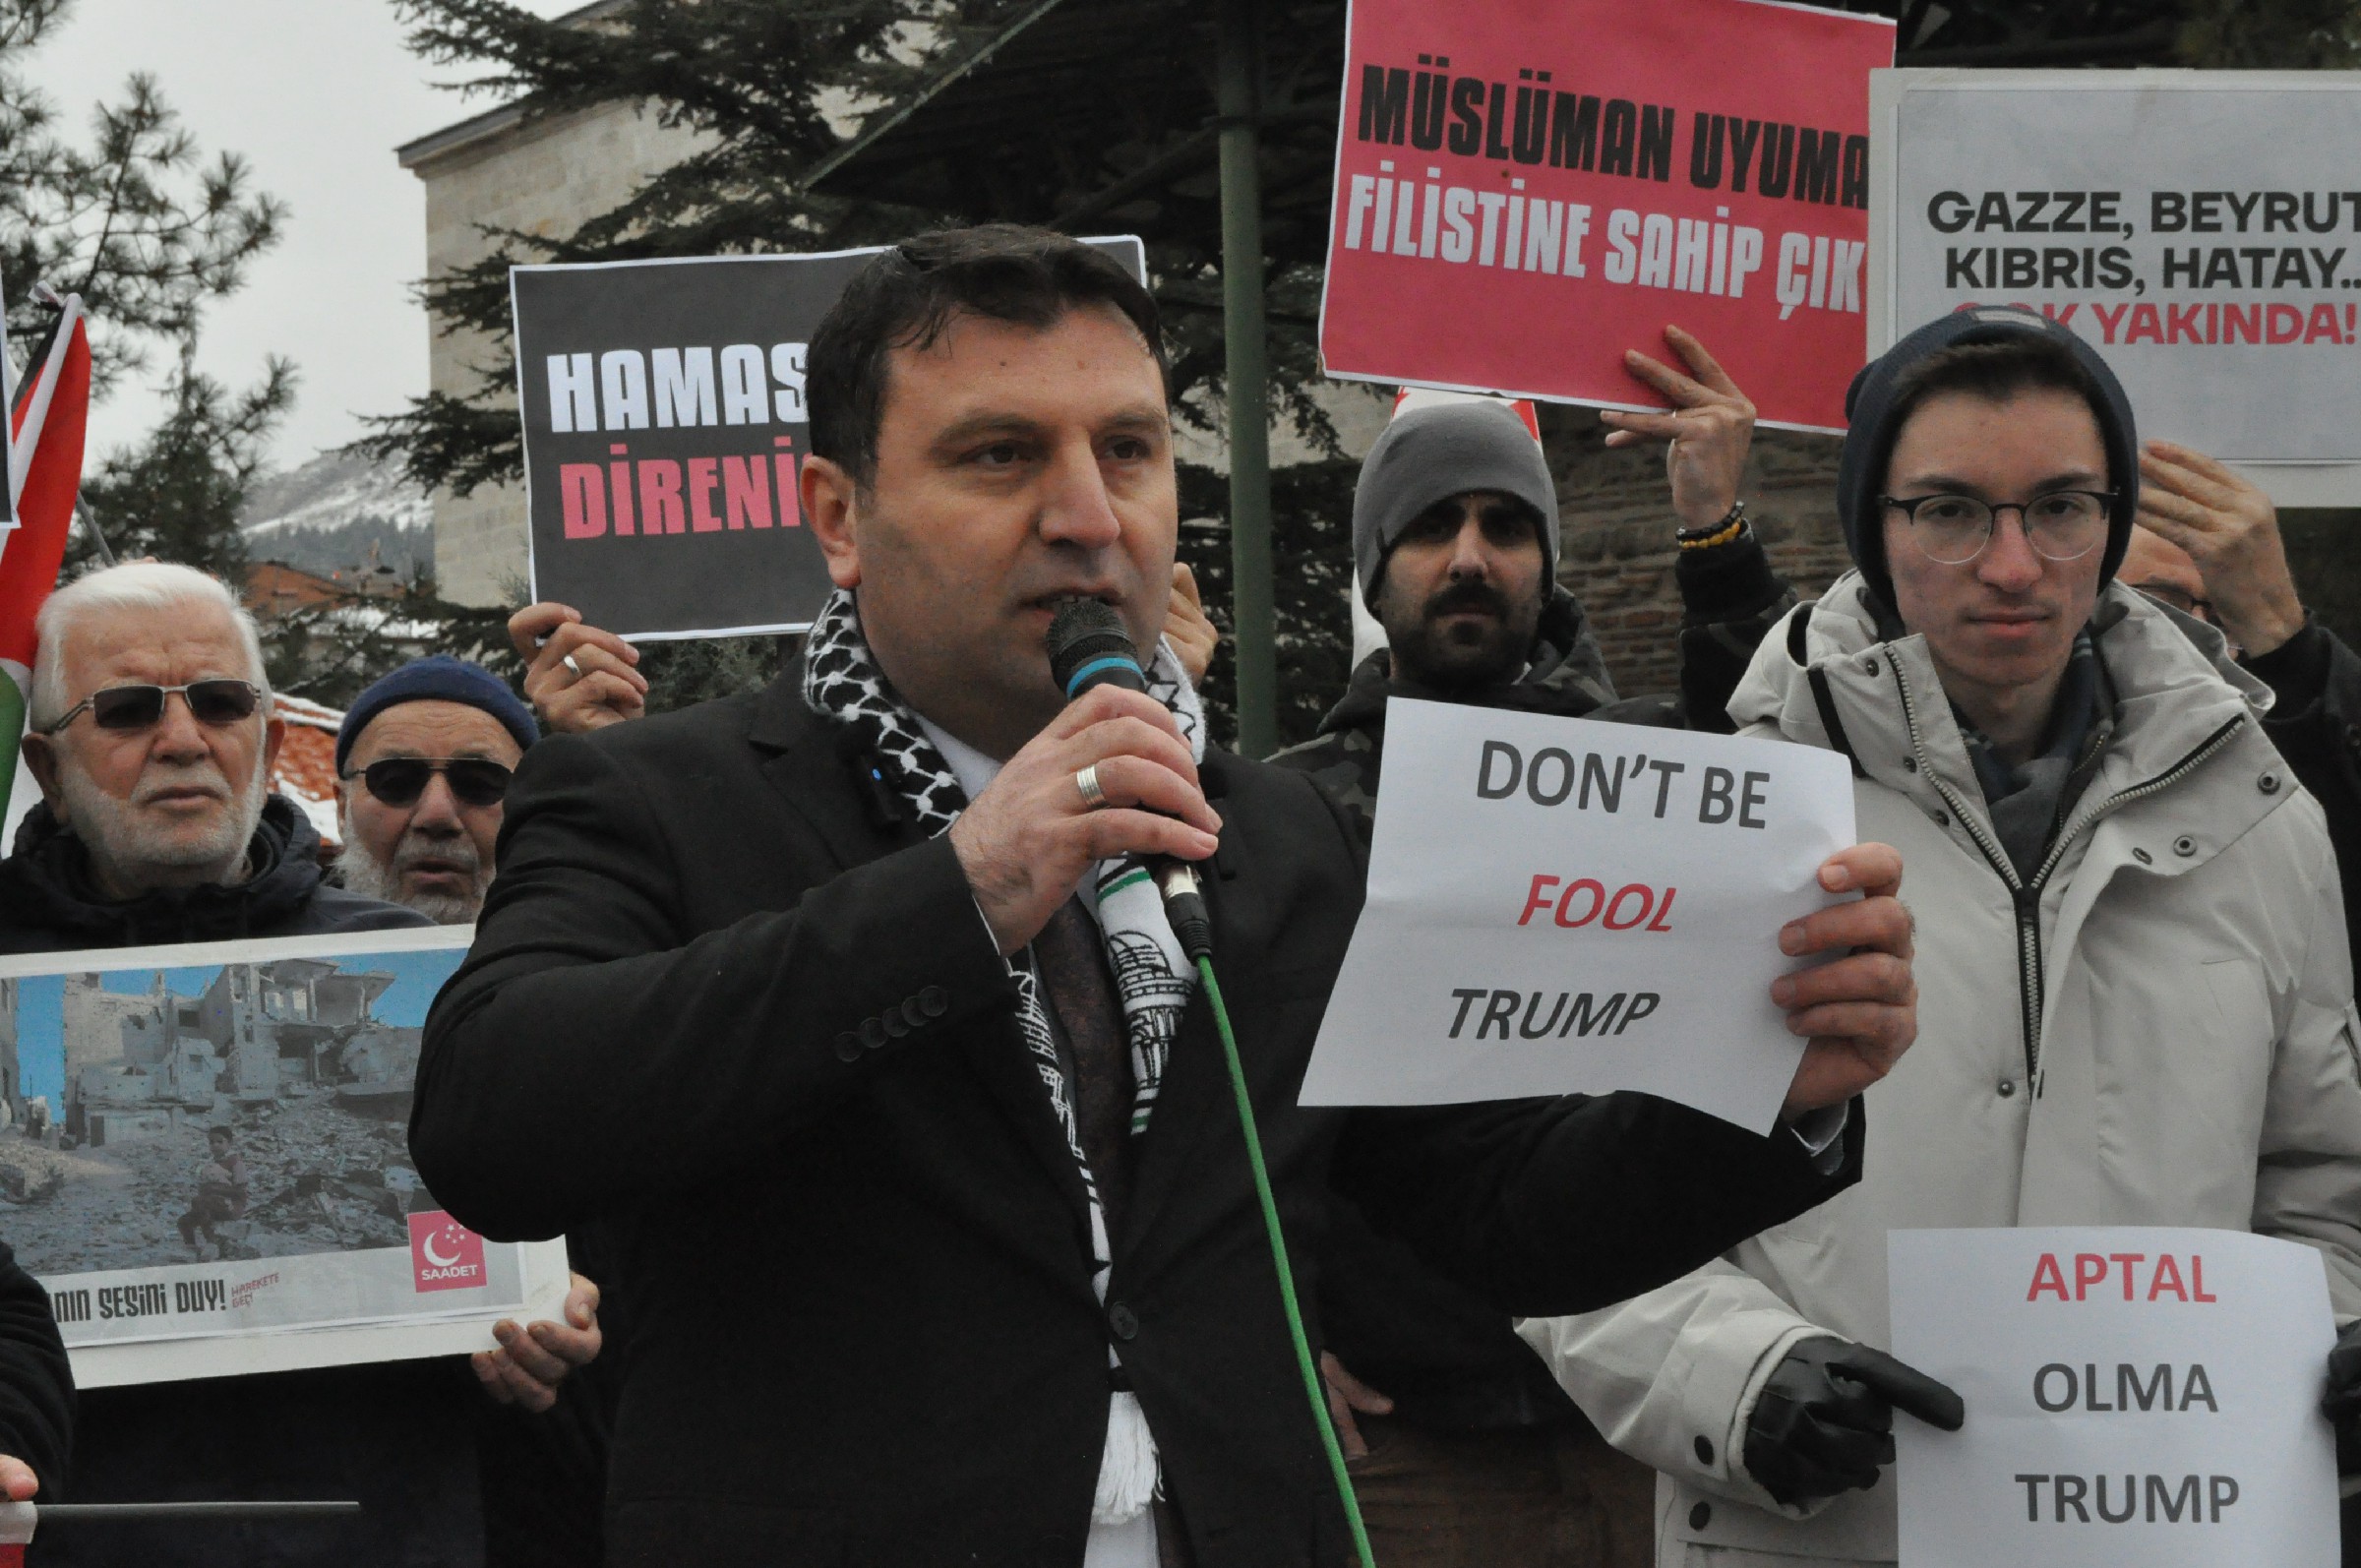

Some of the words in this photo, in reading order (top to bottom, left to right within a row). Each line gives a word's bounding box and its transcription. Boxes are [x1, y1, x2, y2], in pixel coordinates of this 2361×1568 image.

[1358, 54, 1675, 182] MÜSLÜMAN
[1689, 112, 1868, 211] UYUMA
[1345, 159, 1592, 278] FİLİSTİNE
[1604, 206, 1763, 298] SAHİP
[1776, 232, 1865, 321] ÇIK
[1927, 191, 2134, 240] GAZZE,
[2150, 191, 2361, 233] BEYRUT
[1946, 247, 2146, 296] KIBRIS,
[2090, 303, 2357, 345] YAKINDA!
[546, 342, 810, 432] HAMAS
[560, 435, 813, 538] DİRENİ
[1698, 766, 1771, 829] BE
[1518, 874, 1678, 933] FOOL
[1447, 988, 1662, 1041] TRUMP
[231, 1272, 280, 1297] HAREKETE
[421, 1265, 477, 1281] SAADET
[2027, 1252, 2217, 1303] APTAL
[50, 1289, 91, 1323] NIN
[175, 1279, 226, 1313] DUY!
[2032, 1362, 2219, 1414] OLMA
[2014, 1473, 2240, 1525] TRUMP
